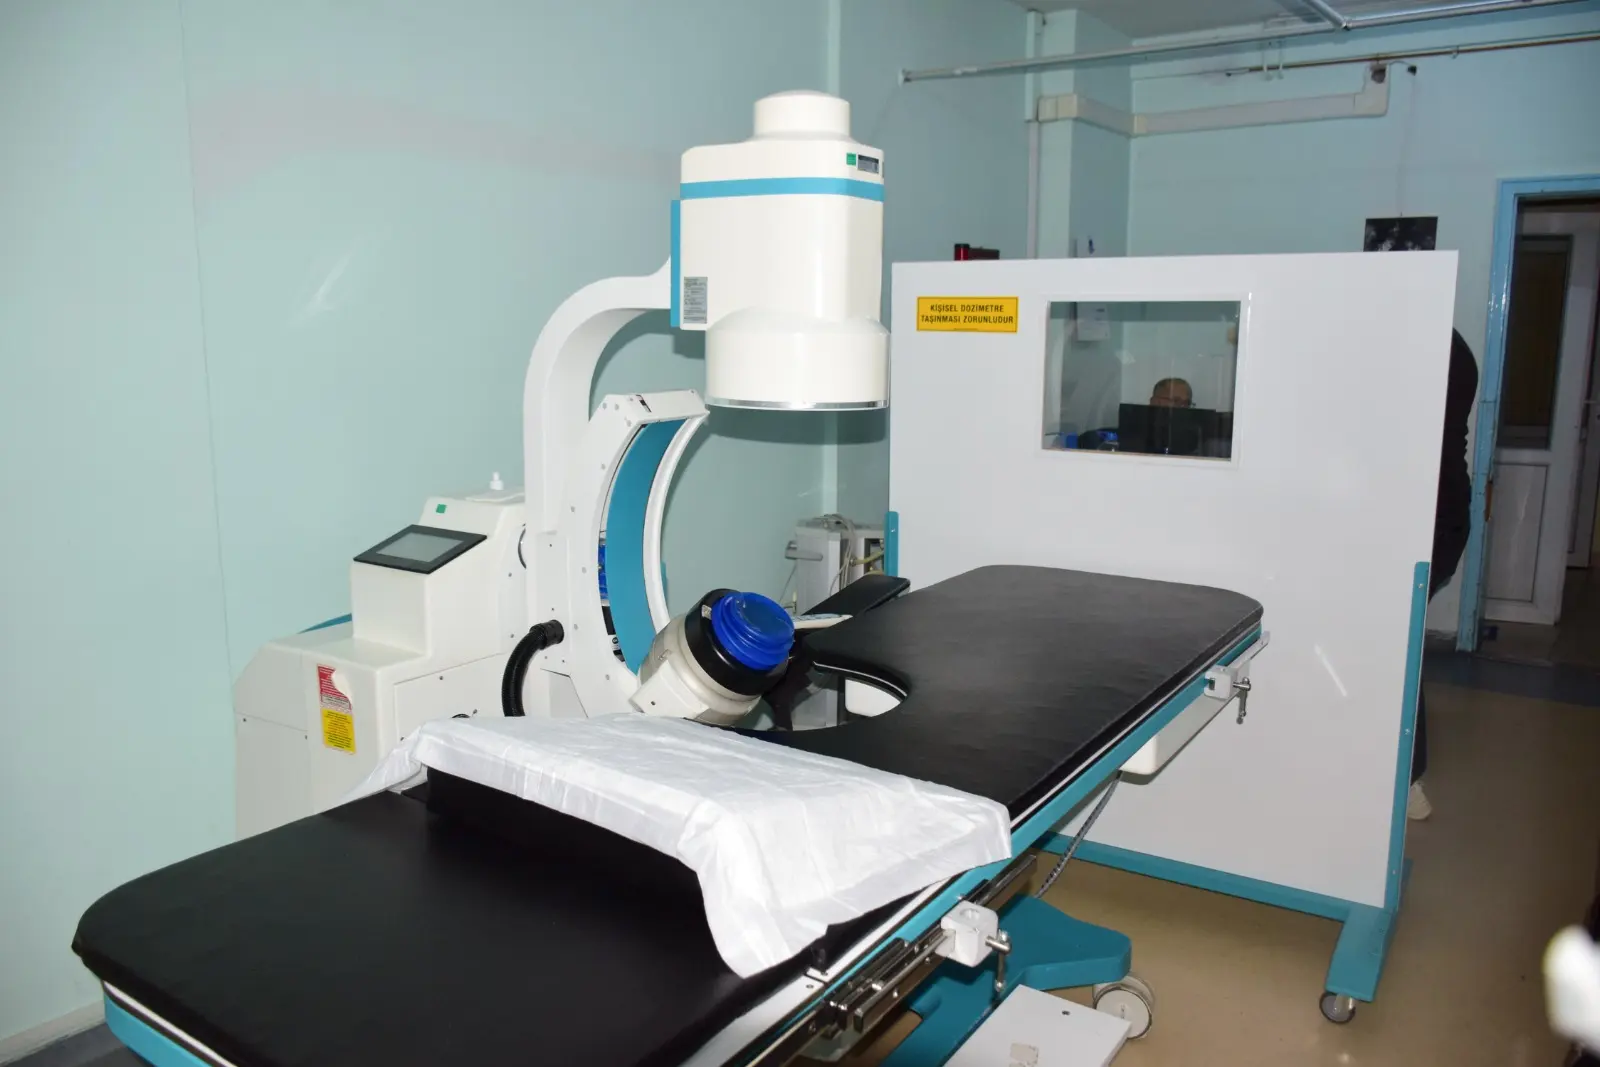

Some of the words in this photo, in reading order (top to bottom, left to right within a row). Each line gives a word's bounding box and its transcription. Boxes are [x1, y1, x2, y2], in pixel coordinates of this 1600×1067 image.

[930, 304, 958, 313] KİŞİSEL
[961, 304, 1004, 312] DOZİMETRE
[921, 315, 961, 324] TAŞINMASI
[963, 315, 1014, 324] ZORUNLUDUR
